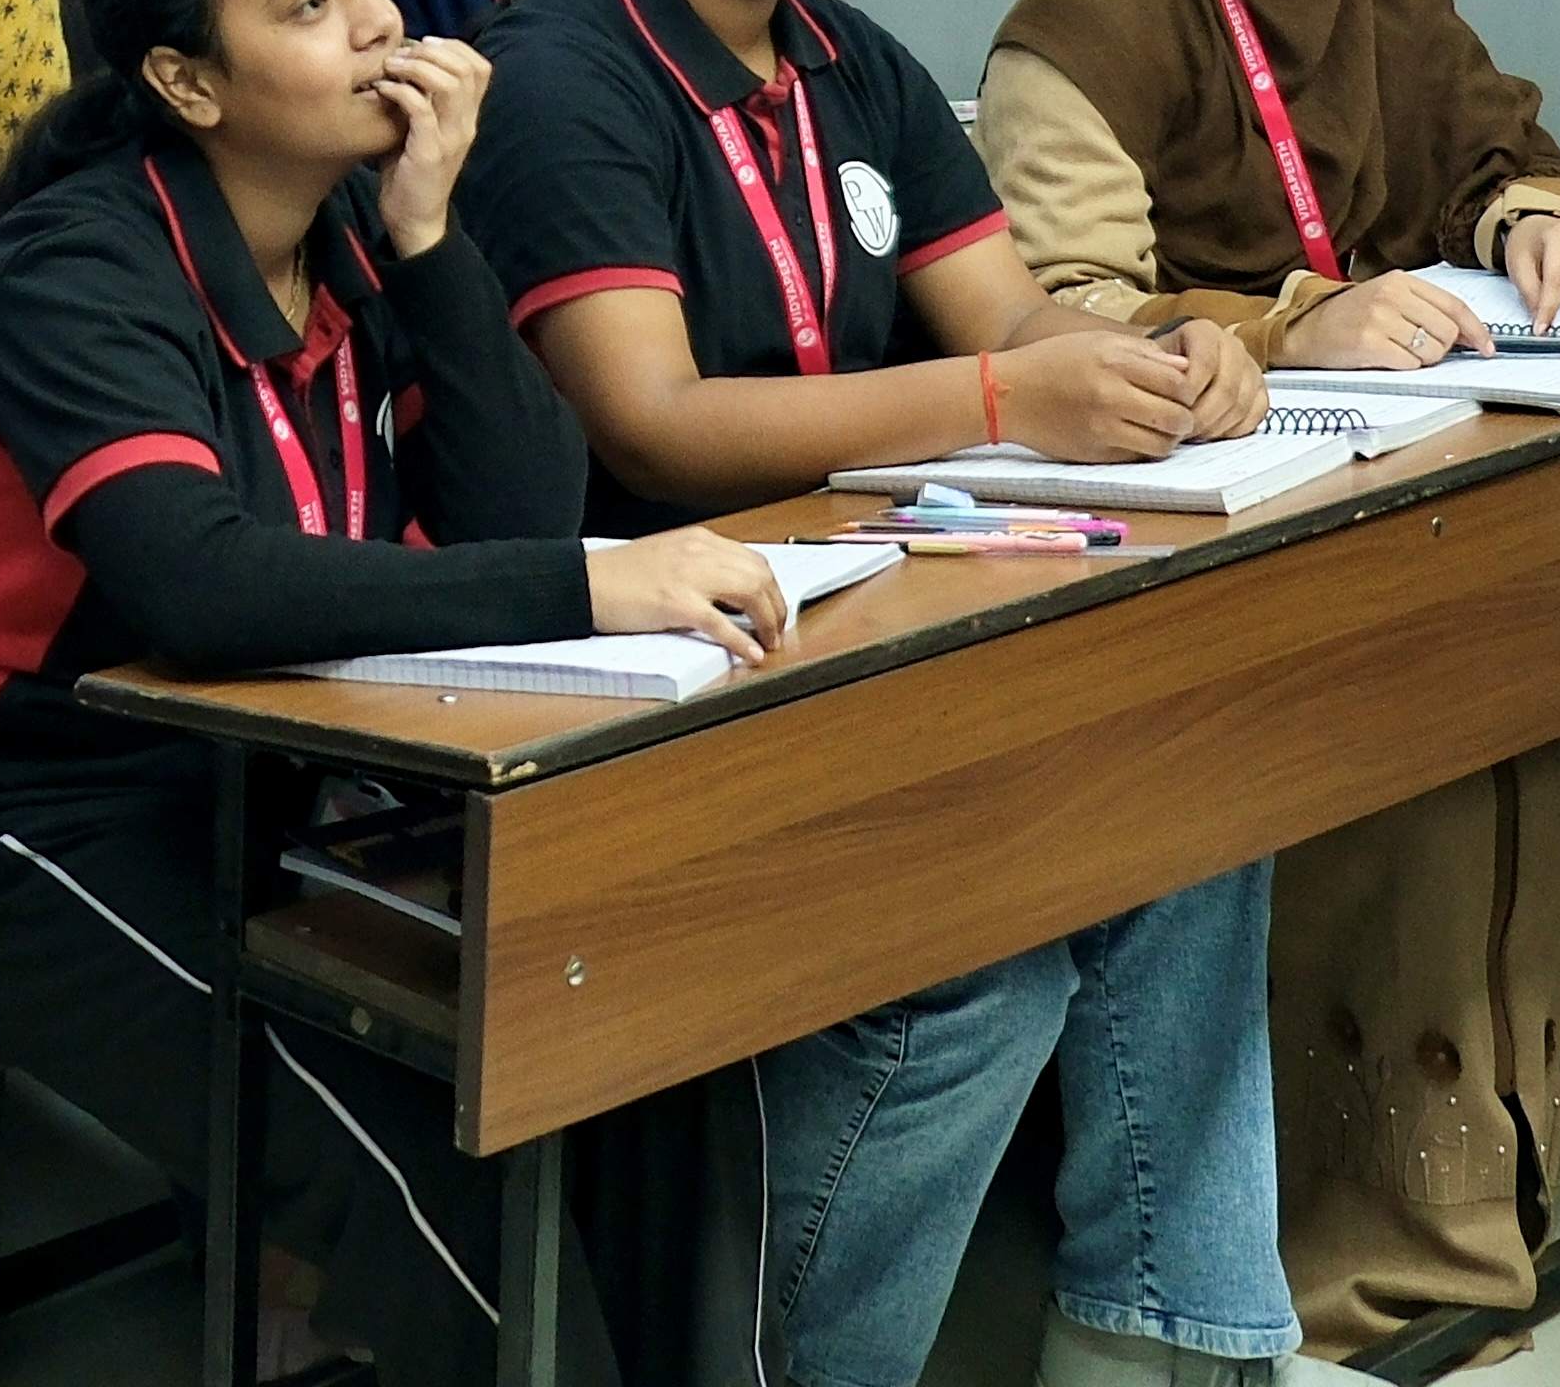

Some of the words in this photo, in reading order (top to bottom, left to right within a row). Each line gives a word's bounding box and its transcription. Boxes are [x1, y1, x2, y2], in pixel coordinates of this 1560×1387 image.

[711, 113, 741, 166] VIDYAP
[1275, 140, 1311, 222] VIDYAPEETH
[768, 238, 803, 327] VIDYAPEETH
